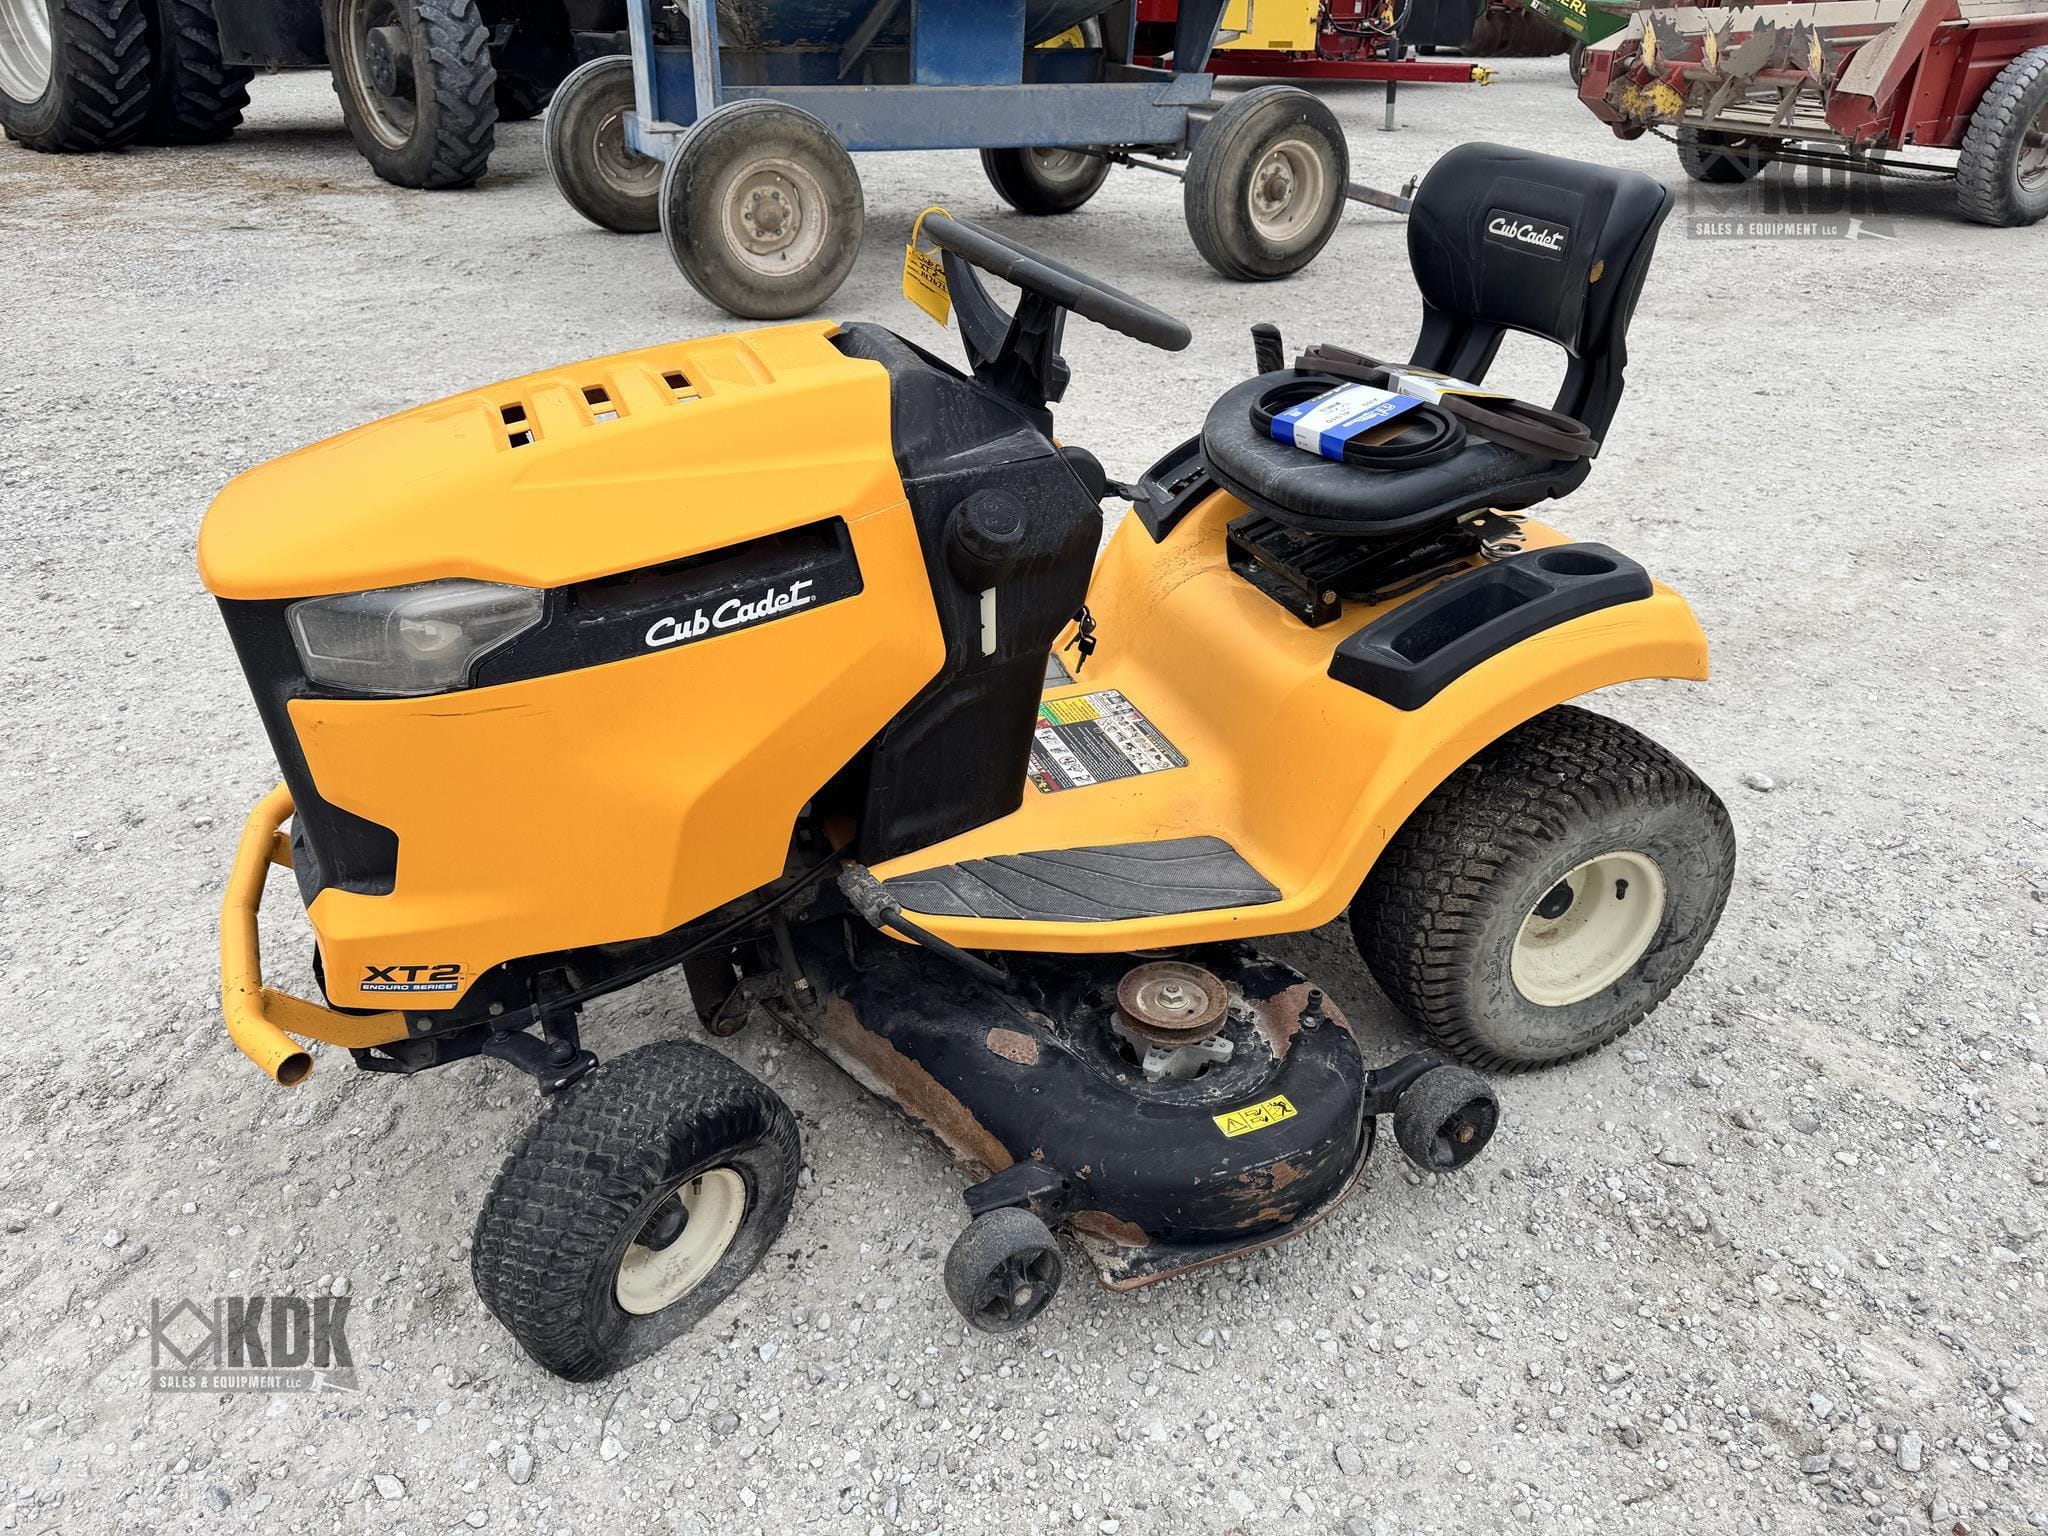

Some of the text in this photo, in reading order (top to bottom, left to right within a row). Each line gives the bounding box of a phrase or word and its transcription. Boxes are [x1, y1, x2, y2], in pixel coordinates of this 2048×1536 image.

[1557, 0, 1587, 17] ERE
[1488, 217, 1517, 238] Cub
[645, 608, 710, 647] Cub
[362, 964, 461, 982] XT2
[362, 983, 453, 991] ENDURO SERIES
